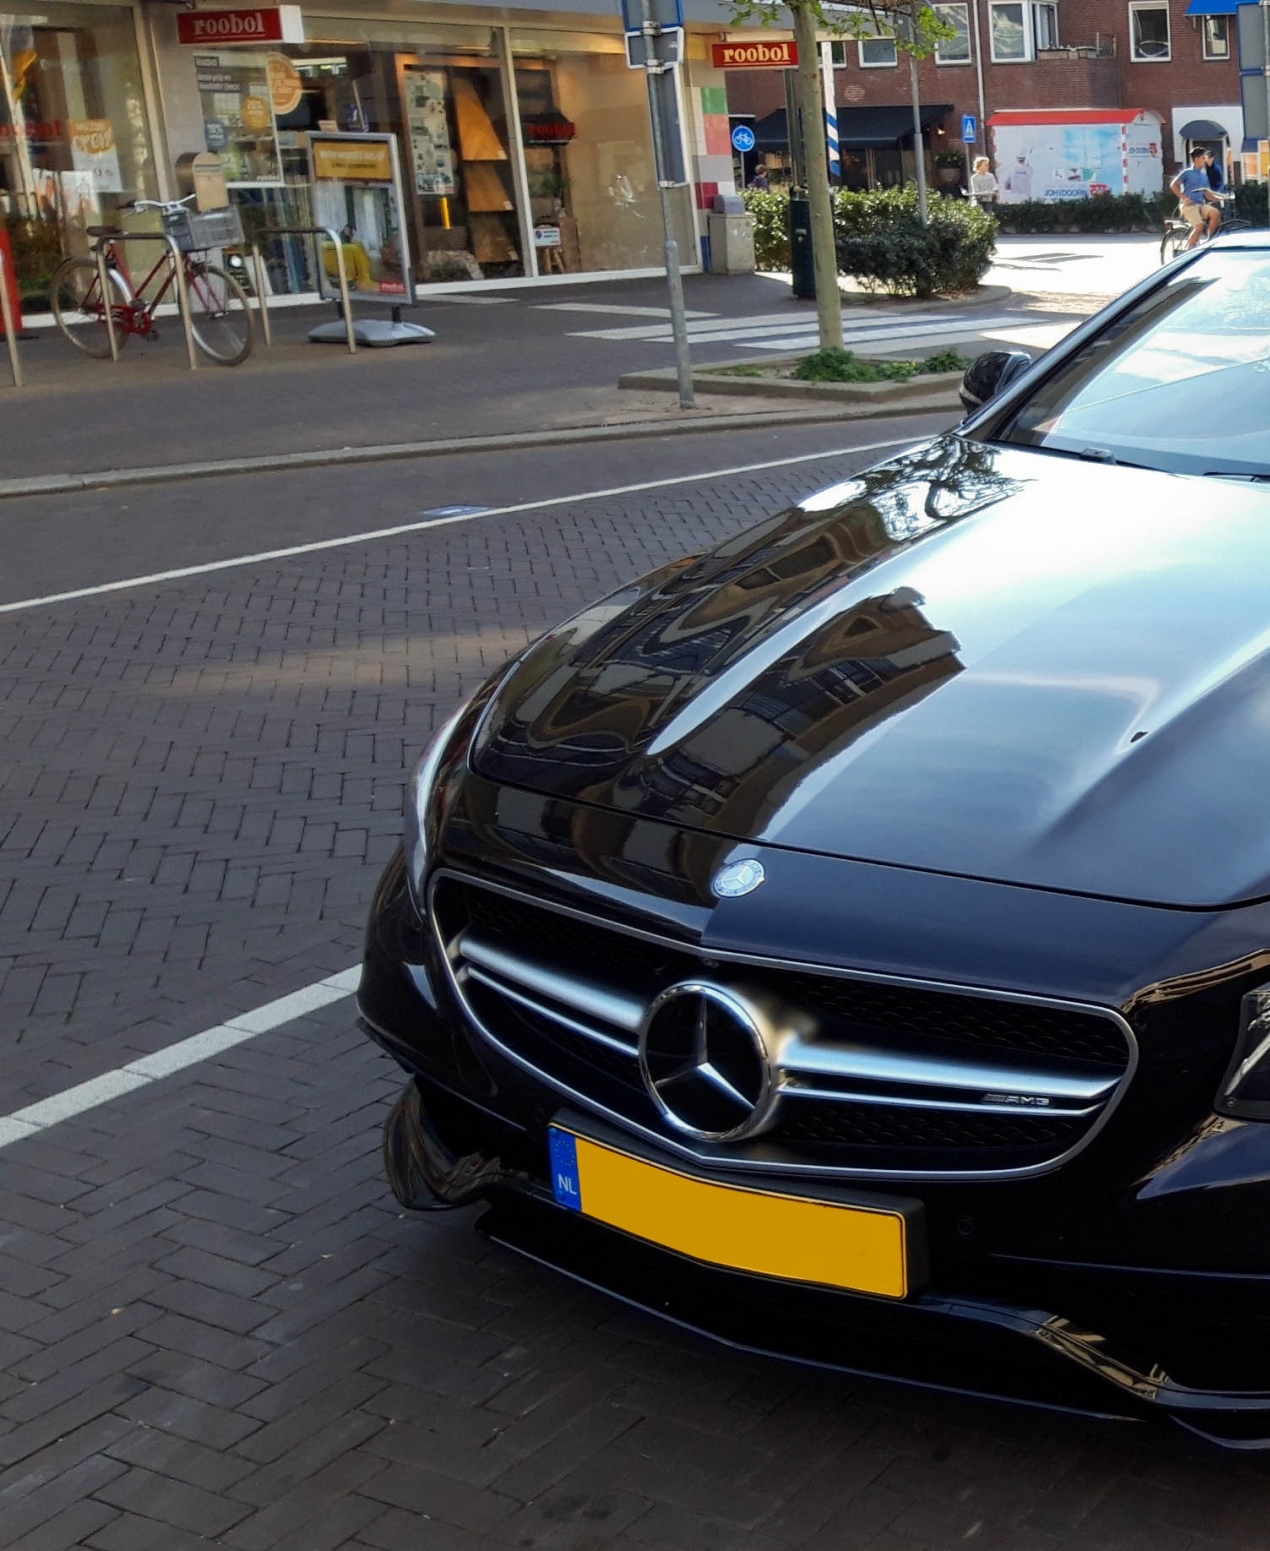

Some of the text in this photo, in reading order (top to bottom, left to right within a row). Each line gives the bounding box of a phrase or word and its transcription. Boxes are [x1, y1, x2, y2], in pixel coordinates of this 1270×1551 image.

[194, 12, 266, 36] roobol
[723, 43, 791, 63] roobol
[1004, 1095, 1050, 1106] AMG
[558, 1173, 578, 1195] NL
